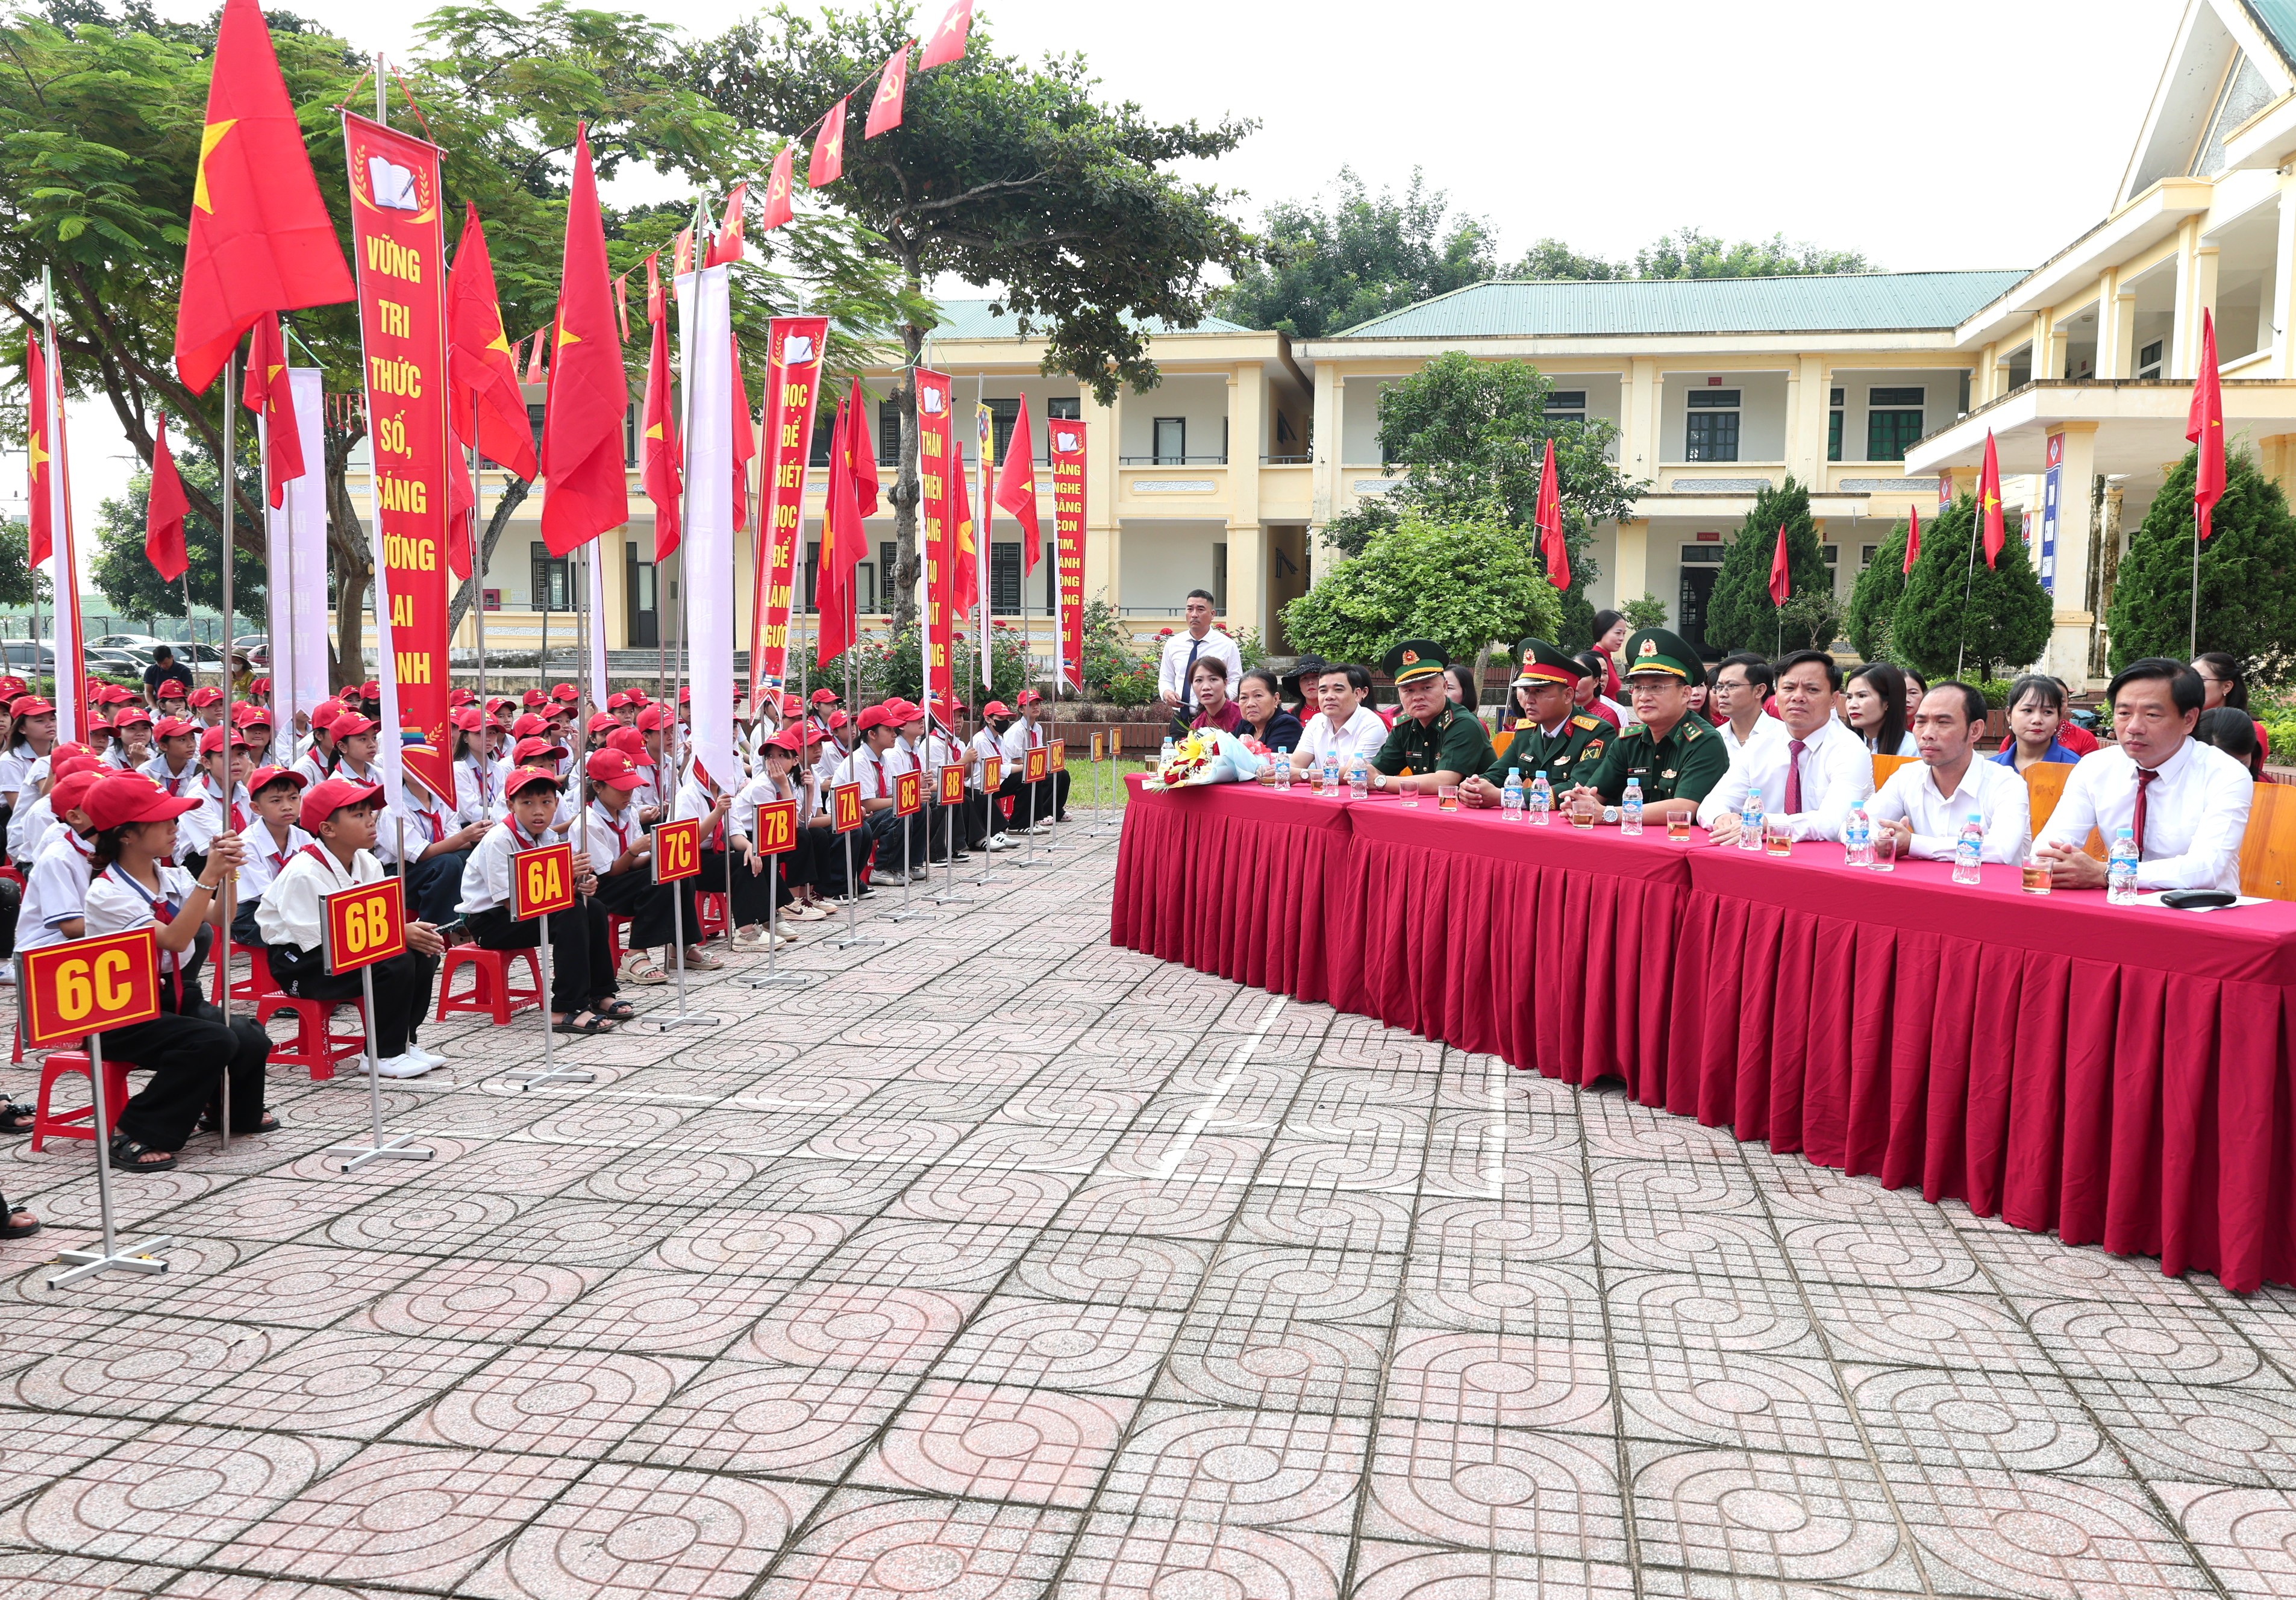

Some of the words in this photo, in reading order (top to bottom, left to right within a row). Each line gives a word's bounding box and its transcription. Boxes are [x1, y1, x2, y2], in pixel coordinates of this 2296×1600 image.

[367, 234, 421, 285] VỮNG
[378, 299, 410, 339] TRI
[370, 355, 422, 399] THỨC
[781, 384, 808, 412] HỌC
[380, 410, 412, 459] SỐ,
[781, 415, 801, 448] ĐỂ
[921, 427, 942, 458] THÂN
[775, 457, 802, 489] BIẾT
[1053, 459, 1081, 476] LẮNG
[375, 470, 427, 514] SÁNG
[922, 470, 942, 505] THIỆN
[1054, 482, 1081, 495] NGHE
[772, 504, 798, 533] HỌC
[925, 511, 941, 543] ÁNG
[1056, 519, 1078, 532] CON
[383, 532, 436, 571] ƯƠNG
[772, 536, 791, 568] ĐỂ
[1059, 555, 1080, 569] ÀNH
[765, 580, 791, 608] LÀM
[1059, 573, 1080, 588] ỘNG
[759, 620, 788, 649] NGƯỜ
[1062, 628, 1071, 642] RÍ
[393, 652, 431, 684] NH
[1053, 745, 1062, 766] 9C
[1095, 738, 1101, 757] 9B
[1113, 733, 1119, 750] 9A
[987, 762, 997, 787] 8A
[1030, 754, 1043, 777] 9D
[901, 779, 916, 808] 8C
[946, 771, 960, 798] 8B
[840, 792, 857, 823] 7A
[765, 810, 788, 845] 7B
[665, 830, 691, 871] 7C
[527, 857, 563, 904] 6A
[345, 896, 389, 954] 6B
[55, 949, 133, 1021] 6C
